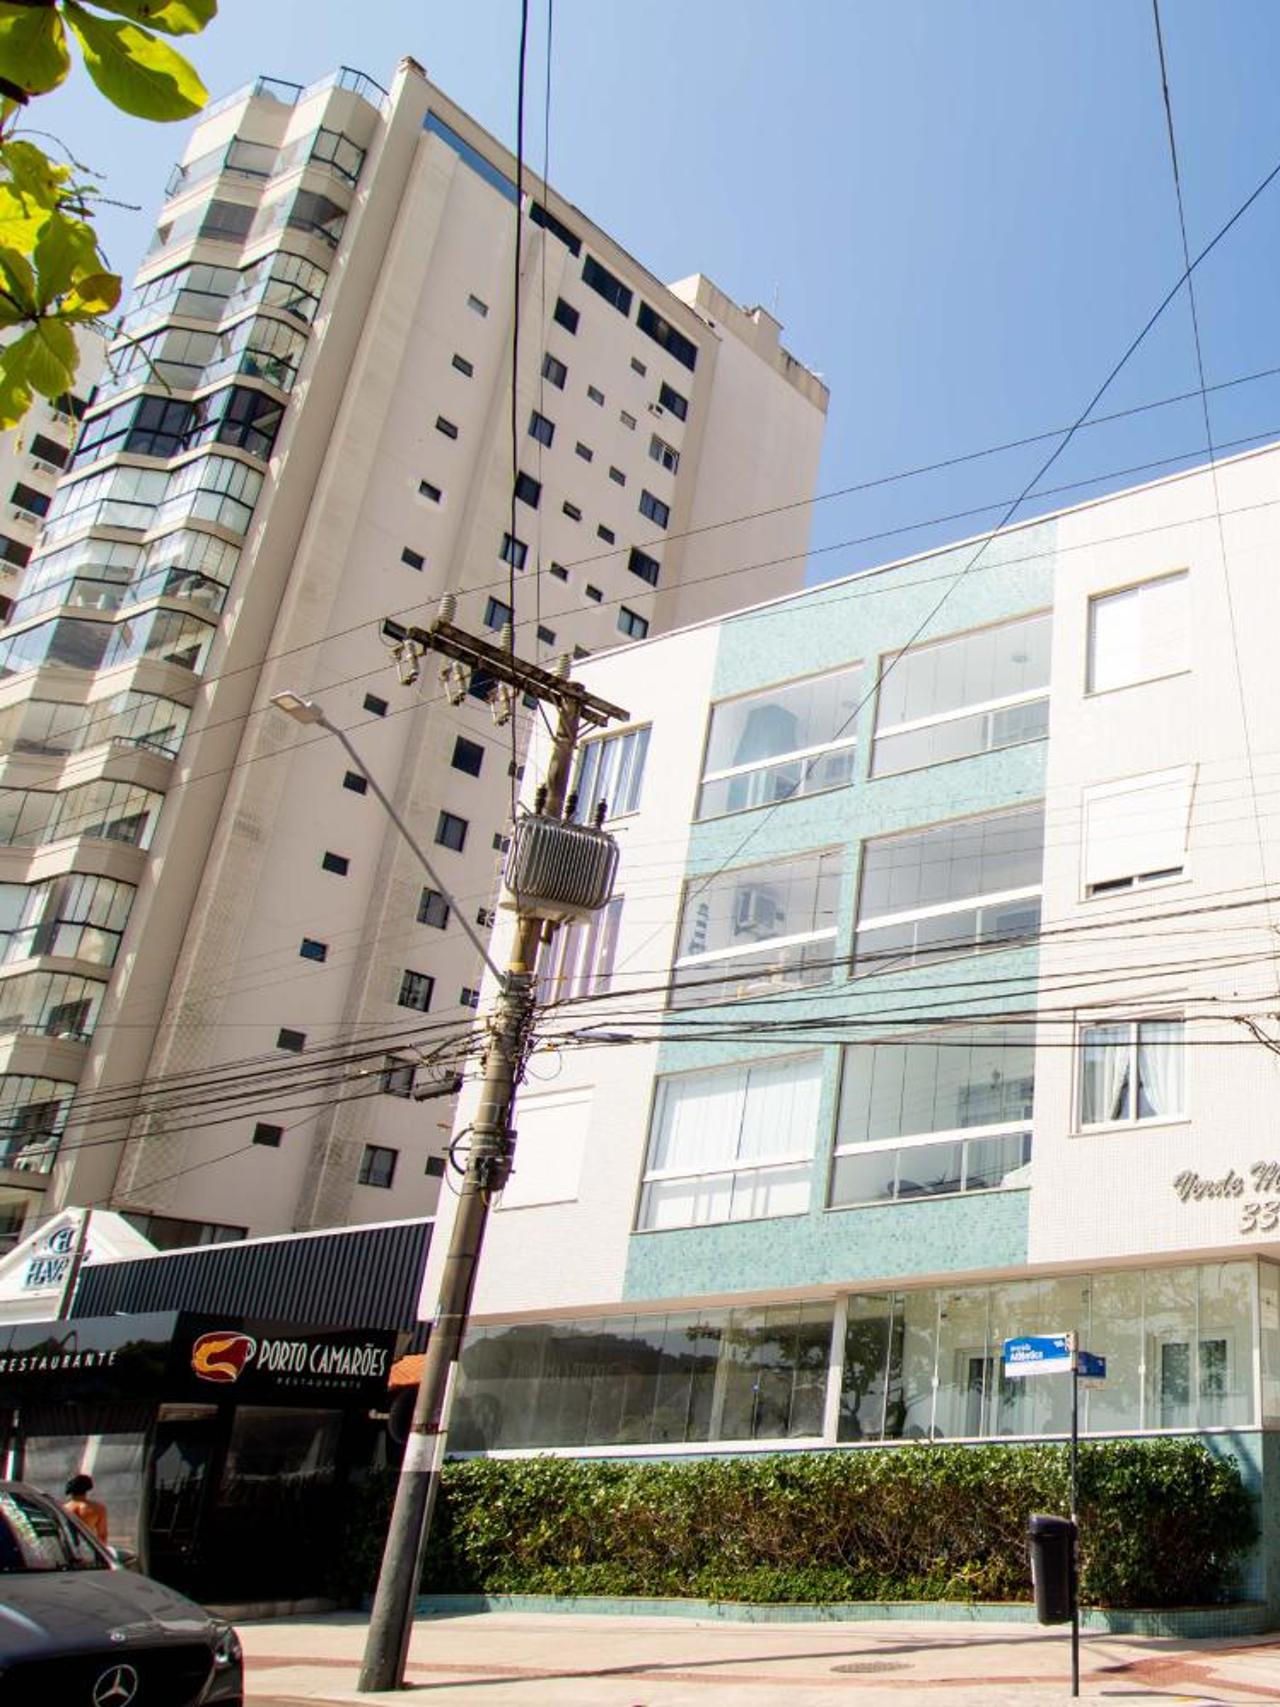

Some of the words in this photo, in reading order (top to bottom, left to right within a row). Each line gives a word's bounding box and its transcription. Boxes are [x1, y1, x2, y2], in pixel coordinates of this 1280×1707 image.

[1172, 1169, 1245, 1203] Verde
[256, 1339, 307, 1372] PORTO
[309, 1342, 389, 1377] CAMARÕES
[276, 1376, 362, 1390] RESTAURANTE
